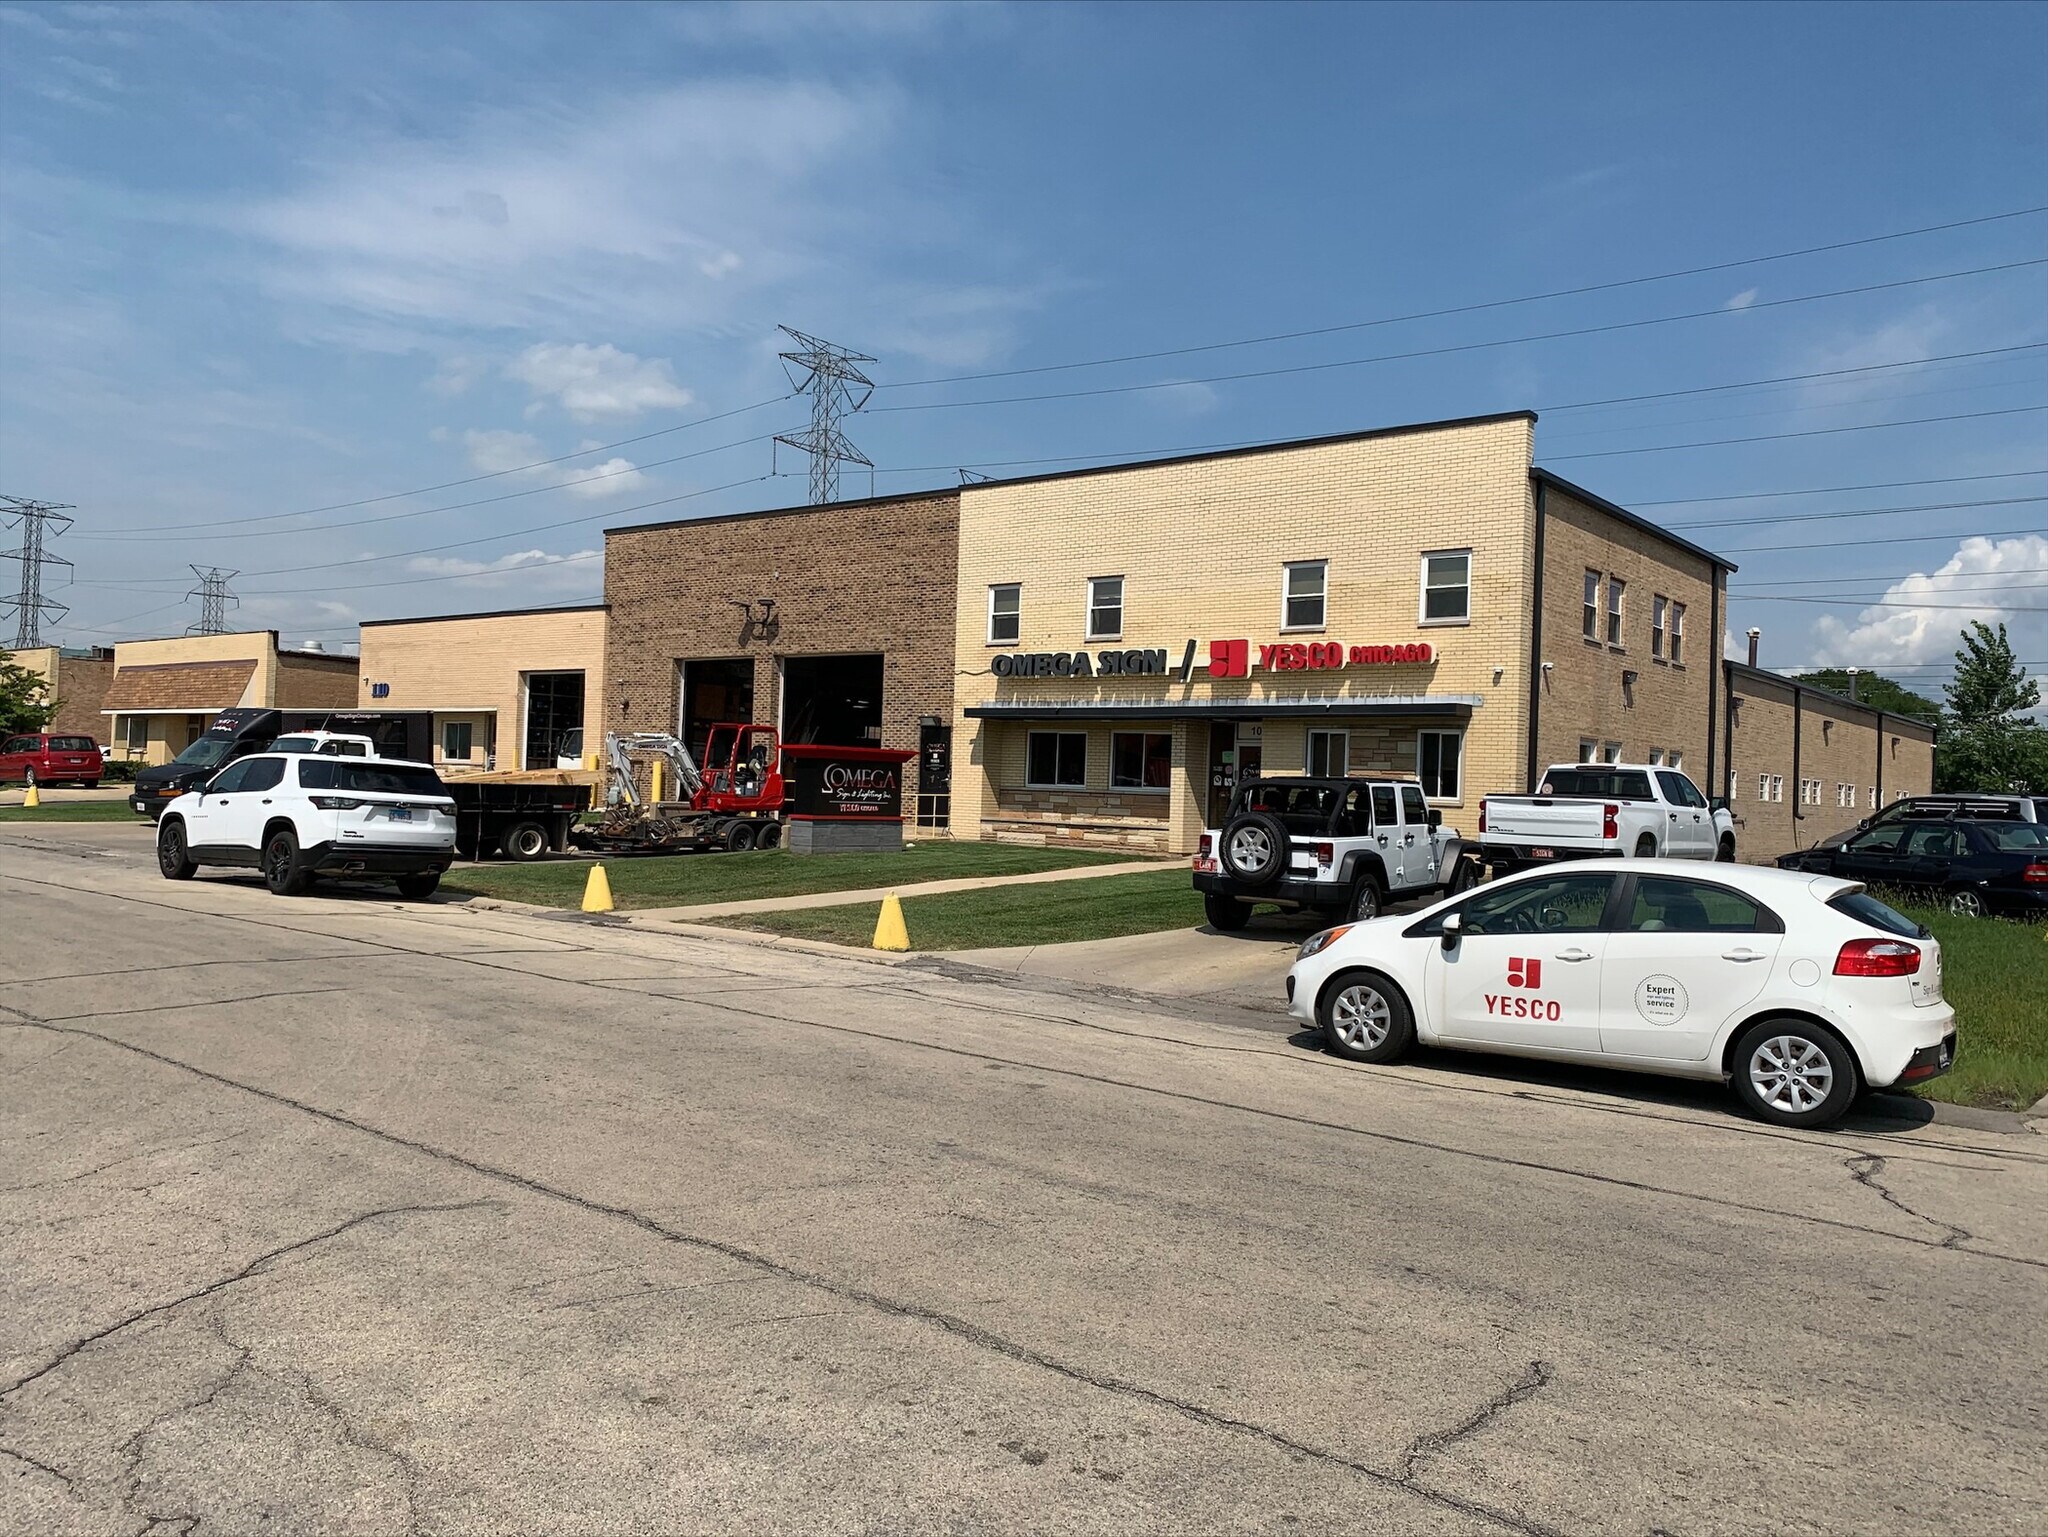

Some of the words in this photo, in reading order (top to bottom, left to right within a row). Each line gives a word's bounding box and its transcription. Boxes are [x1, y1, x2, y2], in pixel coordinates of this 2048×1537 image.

[991, 652, 1093, 677] OMEGA
[1097, 649, 1167, 674] SIGN
[1259, 642, 1343, 669] YESCO
[1350, 643, 1432, 663] CHICAGO
[824, 764, 896, 790] OMEGA
[1646, 984, 1675, 995] Expert
[1484, 994, 1561, 1021] YESCO
[1646, 1000, 1675, 1008] service
